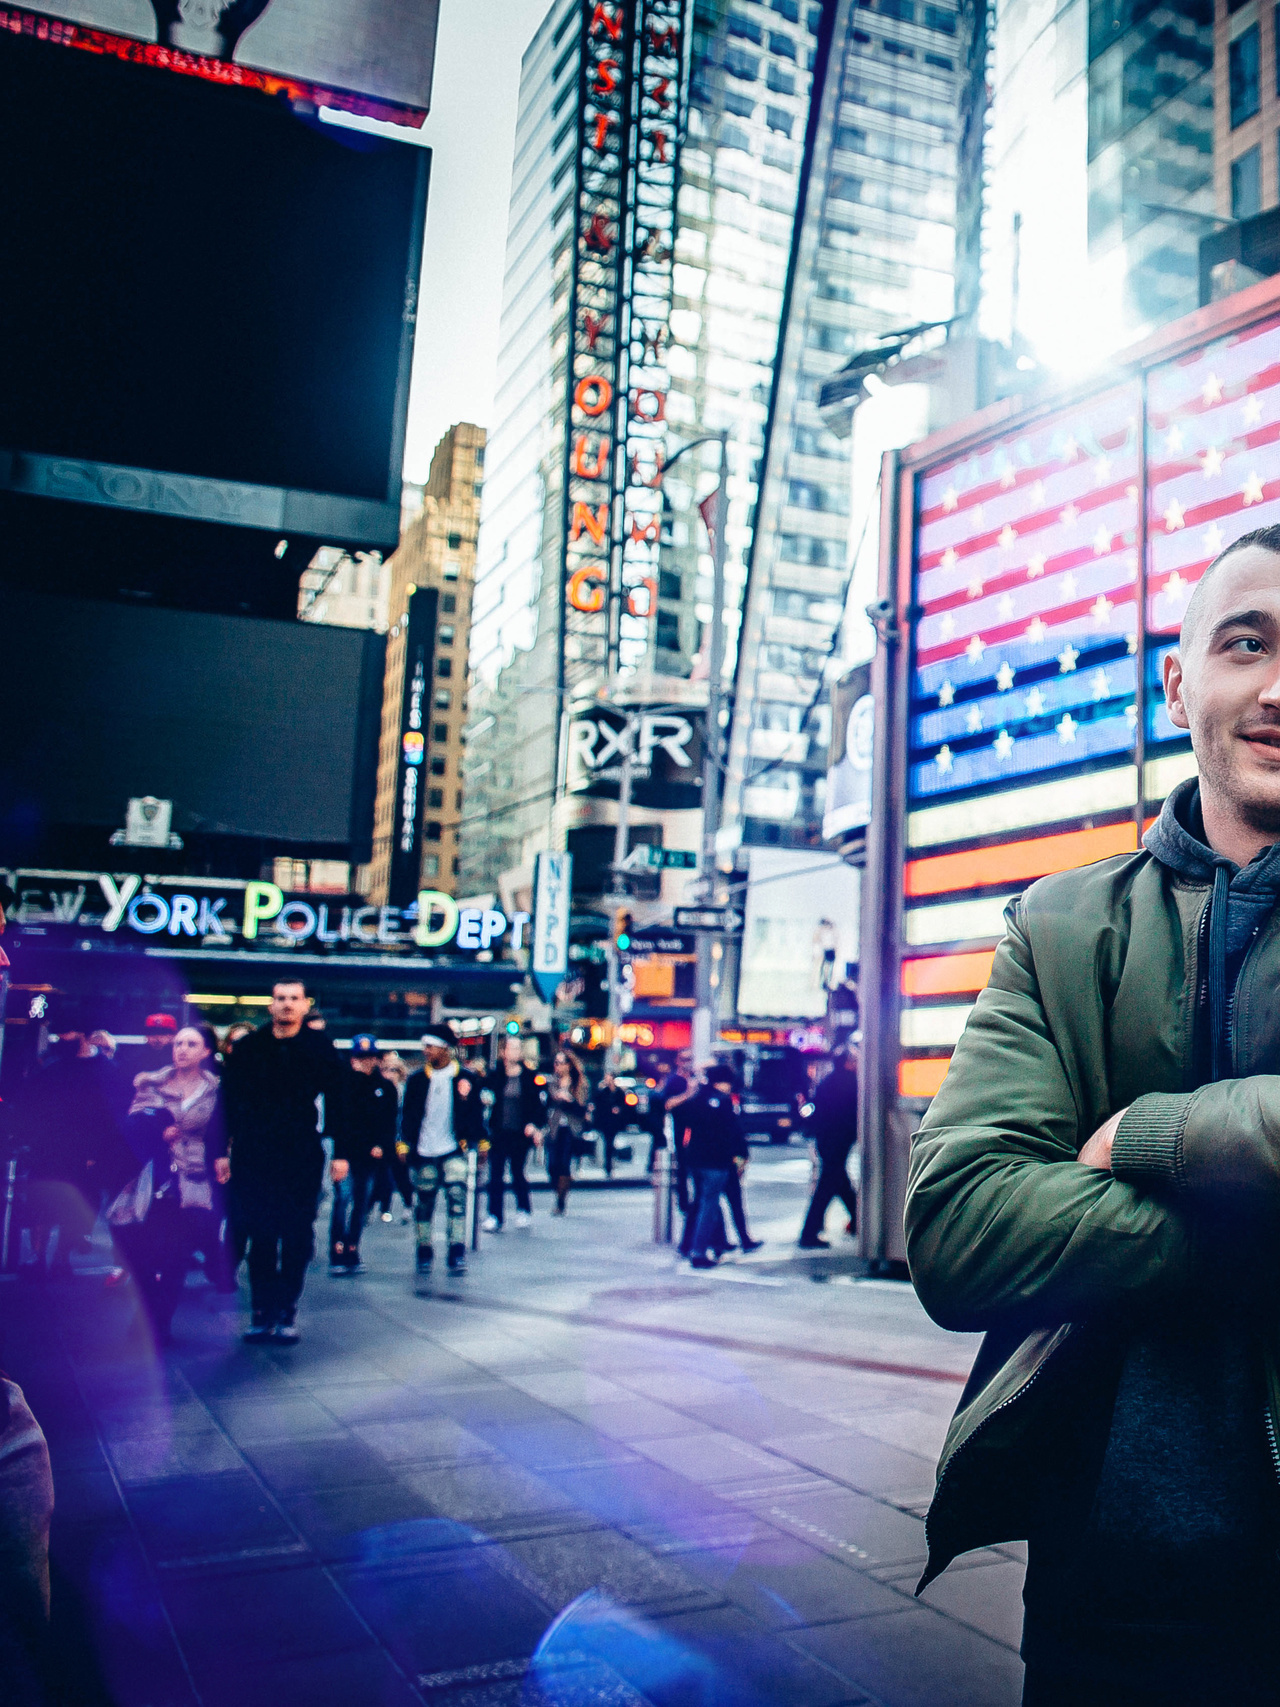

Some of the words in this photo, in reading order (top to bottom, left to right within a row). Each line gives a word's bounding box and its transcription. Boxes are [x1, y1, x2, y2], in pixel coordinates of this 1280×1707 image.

[568, 714, 694, 768] RXR
[99, 872, 228, 937] YORK
[242, 880, 401, 945] POLICE
[416, 889, 531, 950] DEPT
[544, 856, 564, 967] NYPD
